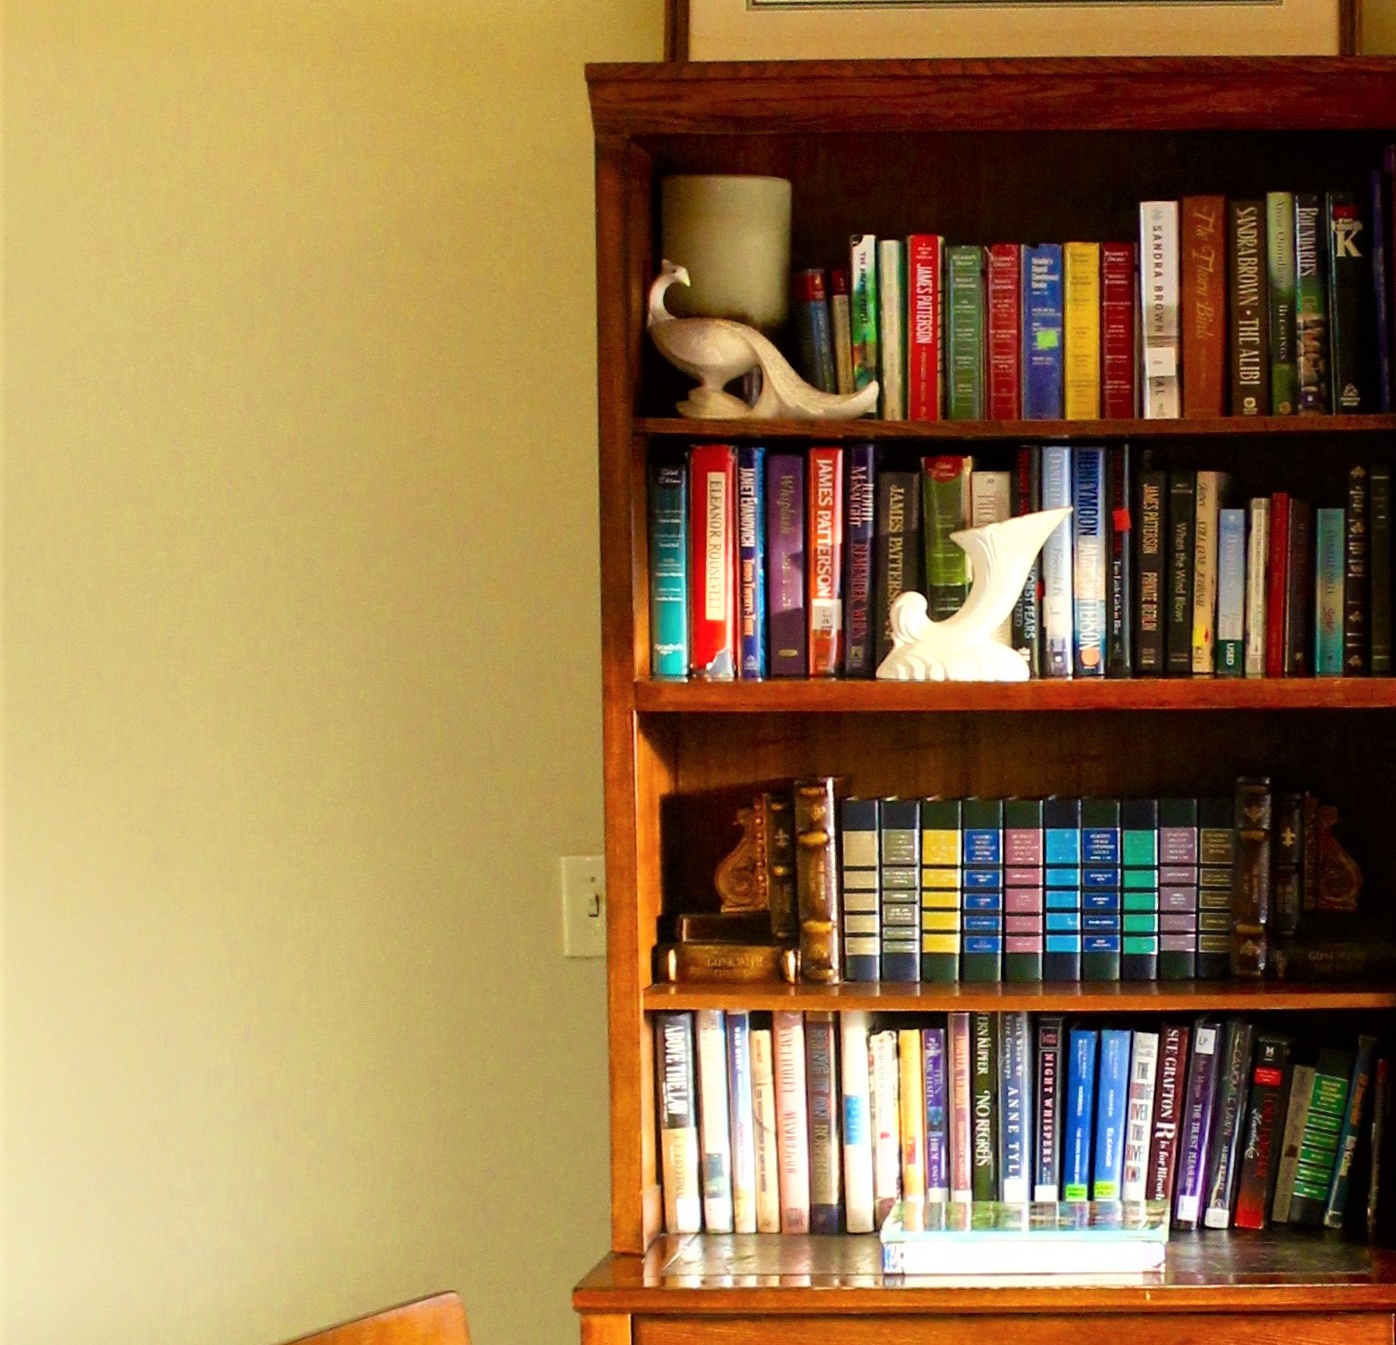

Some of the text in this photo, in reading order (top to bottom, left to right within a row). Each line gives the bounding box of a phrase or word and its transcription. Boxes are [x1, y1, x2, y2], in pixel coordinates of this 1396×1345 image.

[1193, 207, 1216, 238] The
[1298, 208, 1319, 275] BOUNDARIES
[1336, 219, 1363, 257] K
[916, 263, 933, 294] JAMES
[1153, 225, 1165, 332] SANDRA BROWN
[1192, 246, 1216, 295] Thorn
[916, 295, 933, 344] PATTERSON
[1236, 207, 1261, 385] SANDRA BROWN THE ALIBI
[739, 467, 757, 547] JANET EVANOVICH
[776, 475, 795, 534] Whiplash
[860, 483, 874, 521] JUDITH
[888, 484, 905, 532] JAMES
[1077, 451, 1099, 536] HONEYMOON
[708, 480, 723, 611] ELEANOR ROOSEVELT
[816, 459, 833, 598] JAMES PATTERSON
[1142, 483, 1159, 631] JAMES PATTERSON PRIVATE BERLIN
[1174, 523, 1187, 622] When the Wind Blows
[1024, 606, 1036, 638] FEARS
[1113, 619, 1122, 635] Blue
[1226, 643, 1234, 665] USED
[664, 1025, 688, 1115] ABOVE THE LAW
[976, 1037, 991, 1075] KUPFER
[1003, 1037, 1013, 1079] Grownups
[1015, 1039, 1023, 1061] When
[812, 1096, 830, 1120] ON
[975, 1090, 990, 1117] NO
[1043, 1053, 1055, 1164] NIGHT WHISPERS
[1155, 1029, 1179, 1200] SUE GRAFTON R is for Ricoch
[1192, 1104, 1202, 1119] THE
[1224, 1107, 1234, 1135] LAWN
[975, 1119, 991, 1166] REGRETS
[1007, 1086, 1020, 1179] ANNE TYL
[1105, 1127, 1114, 1167] ELEANOR
[1186, 1152, 1198, 1189] PLEASURE
